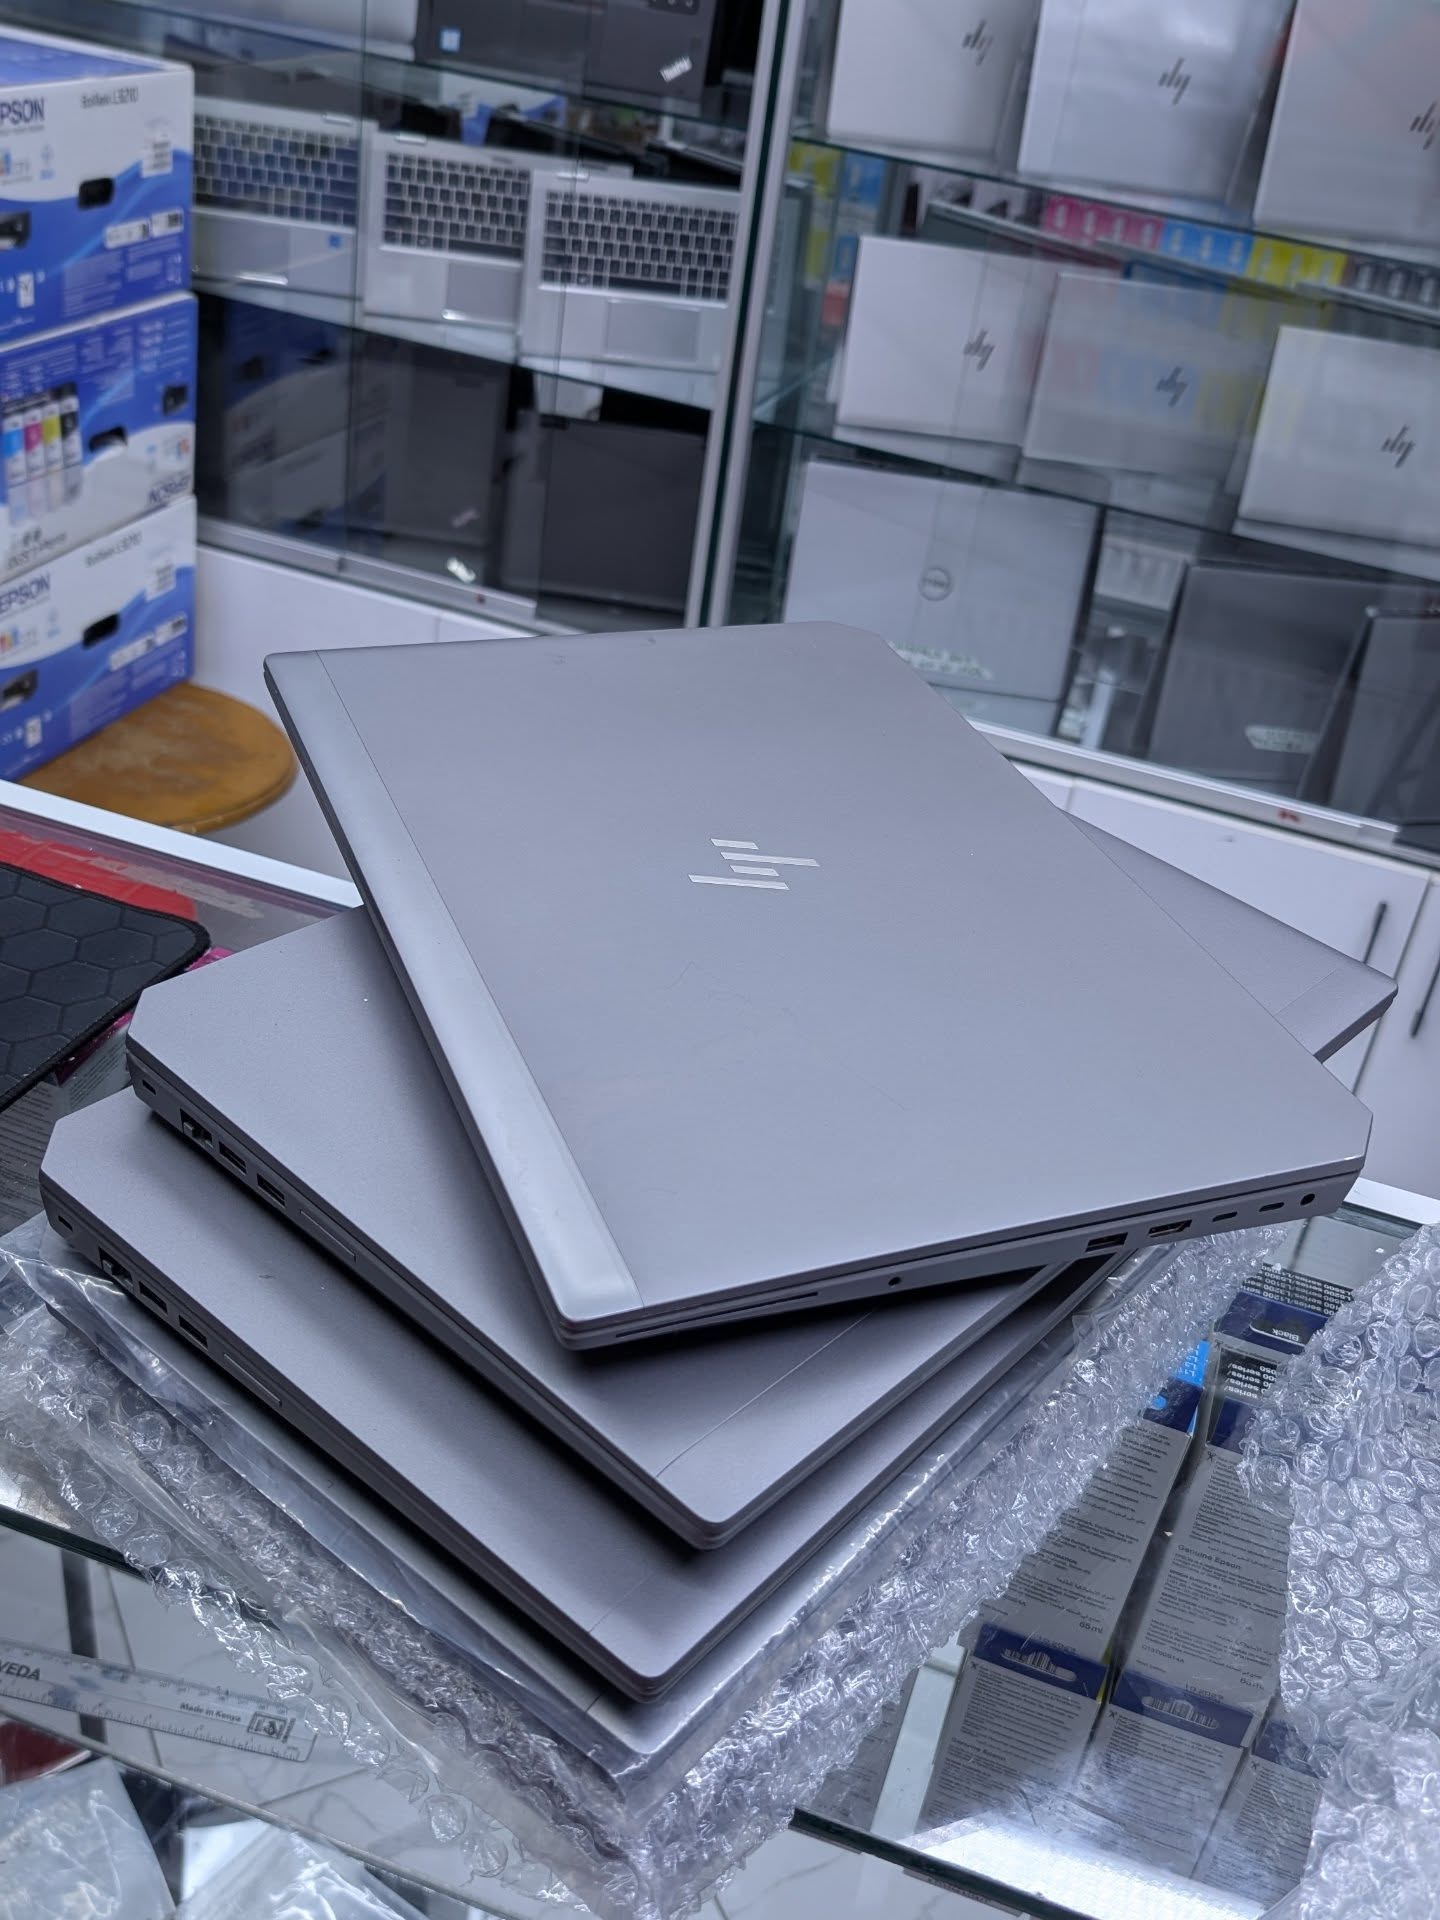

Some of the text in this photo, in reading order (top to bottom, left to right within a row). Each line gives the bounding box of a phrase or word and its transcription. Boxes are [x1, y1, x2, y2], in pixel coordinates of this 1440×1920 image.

[0, 97, 45, 125] PSON
[1272, 1328, 1299, 1342] Black
[1178, 1544, 1241, 1570] Genuine Epson
[180, 1702, 241, 1721] Made in Kenya
